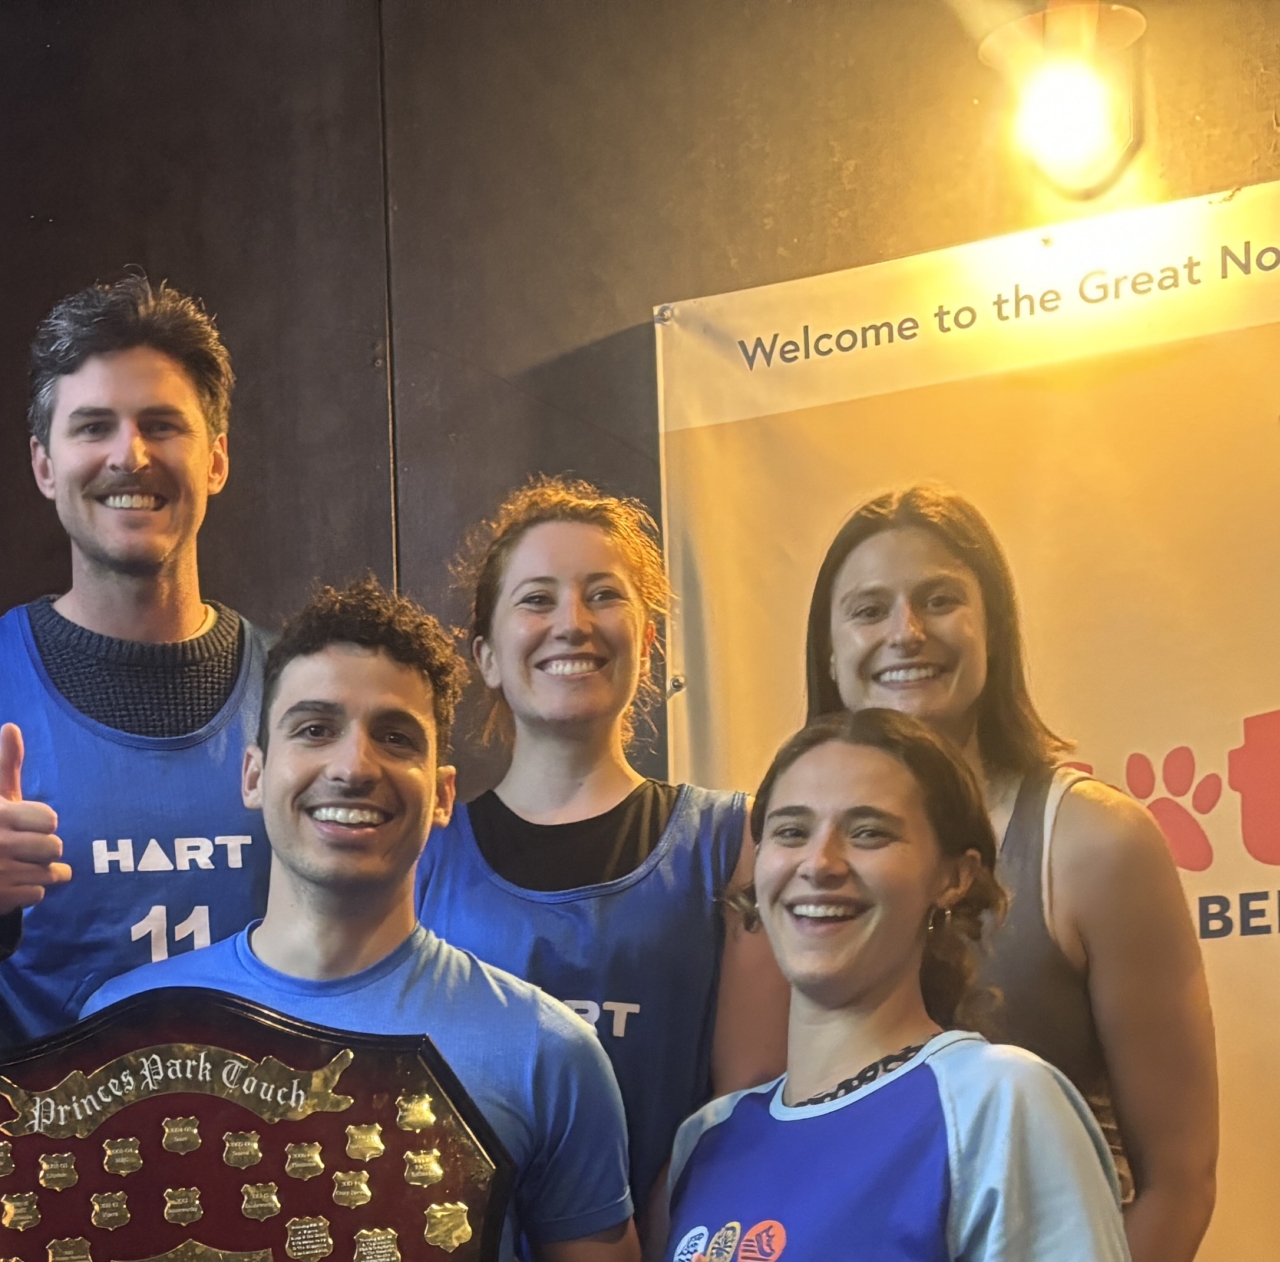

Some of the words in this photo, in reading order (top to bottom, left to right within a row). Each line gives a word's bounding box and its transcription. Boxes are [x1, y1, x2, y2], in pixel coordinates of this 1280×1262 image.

[738, 317, 919, 372] Welcome
[934, 304, 977, 333] to
[992, 284, 1061, 321] the
[1078, 255, 1202, 306] Great
[92, 835, 252, 873] HART
[131, 905, 211, 963] 11
[1198, 889, 1280, 939] BE
[25, 1067, 135, 1133] Princes
[139, 1050, 212, 1092] Park
[222, 1058, 307, 1112] Touch
